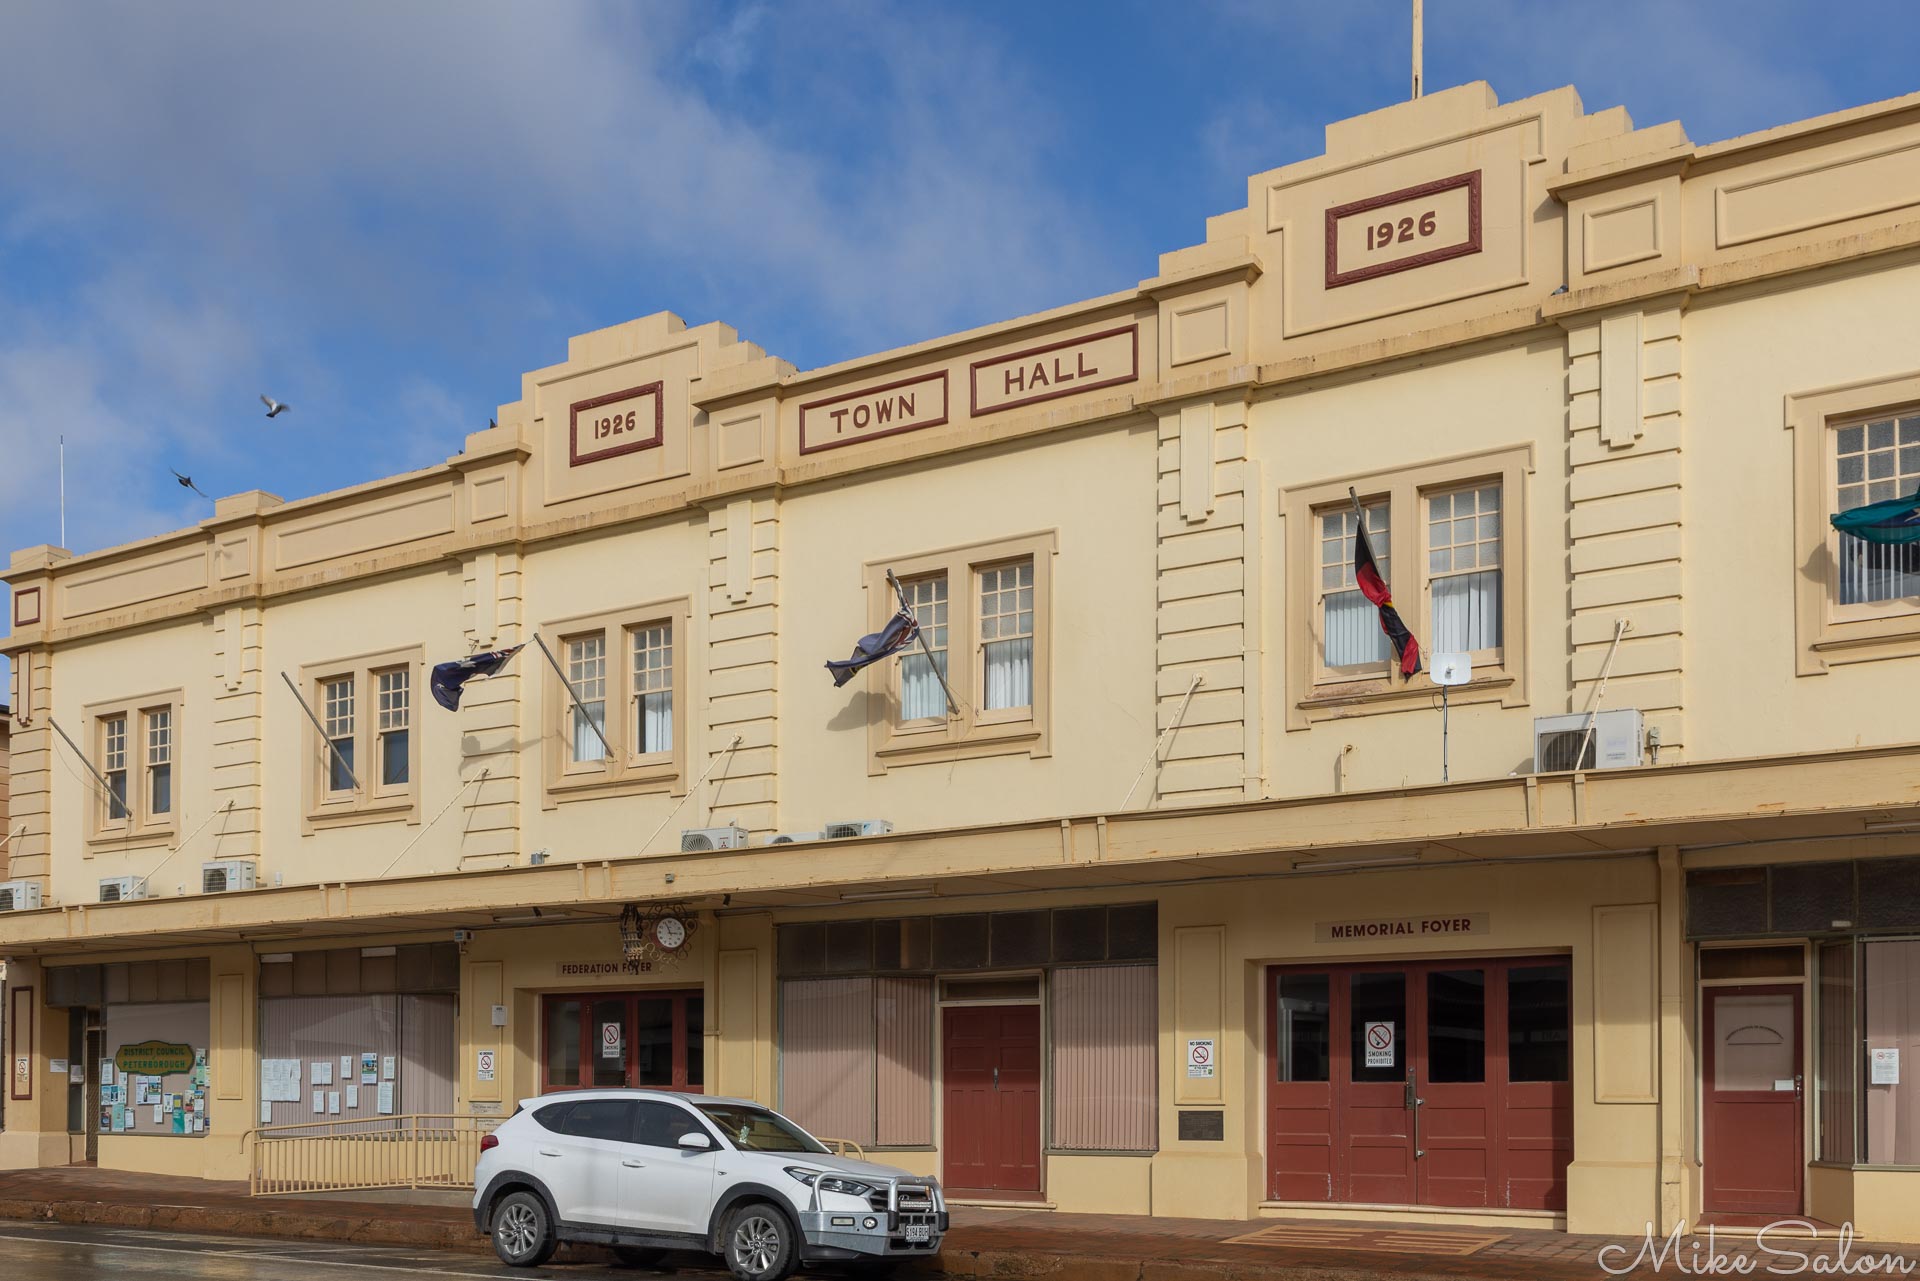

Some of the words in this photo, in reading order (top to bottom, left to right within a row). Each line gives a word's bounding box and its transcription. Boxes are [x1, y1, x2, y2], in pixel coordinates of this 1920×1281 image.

[1367, 210, 1436, 251] 1926
[829, 392, 916, 434] TOWN
[1004, 352, 1099, 395] HALL
[594, 410, 636, 440] 1926
[1331, 921, 1414, 939] MEMORIAL
[1421, 918, 1471, 934] FOYER
[562, 963, 618, 975] FEDERATION
[123, 1047, 154, 1056] DISTRICT
[156, 1047, 185, 1056] COUNCIL
[123, 1060, 185, 1069] PETERBOROUGH
